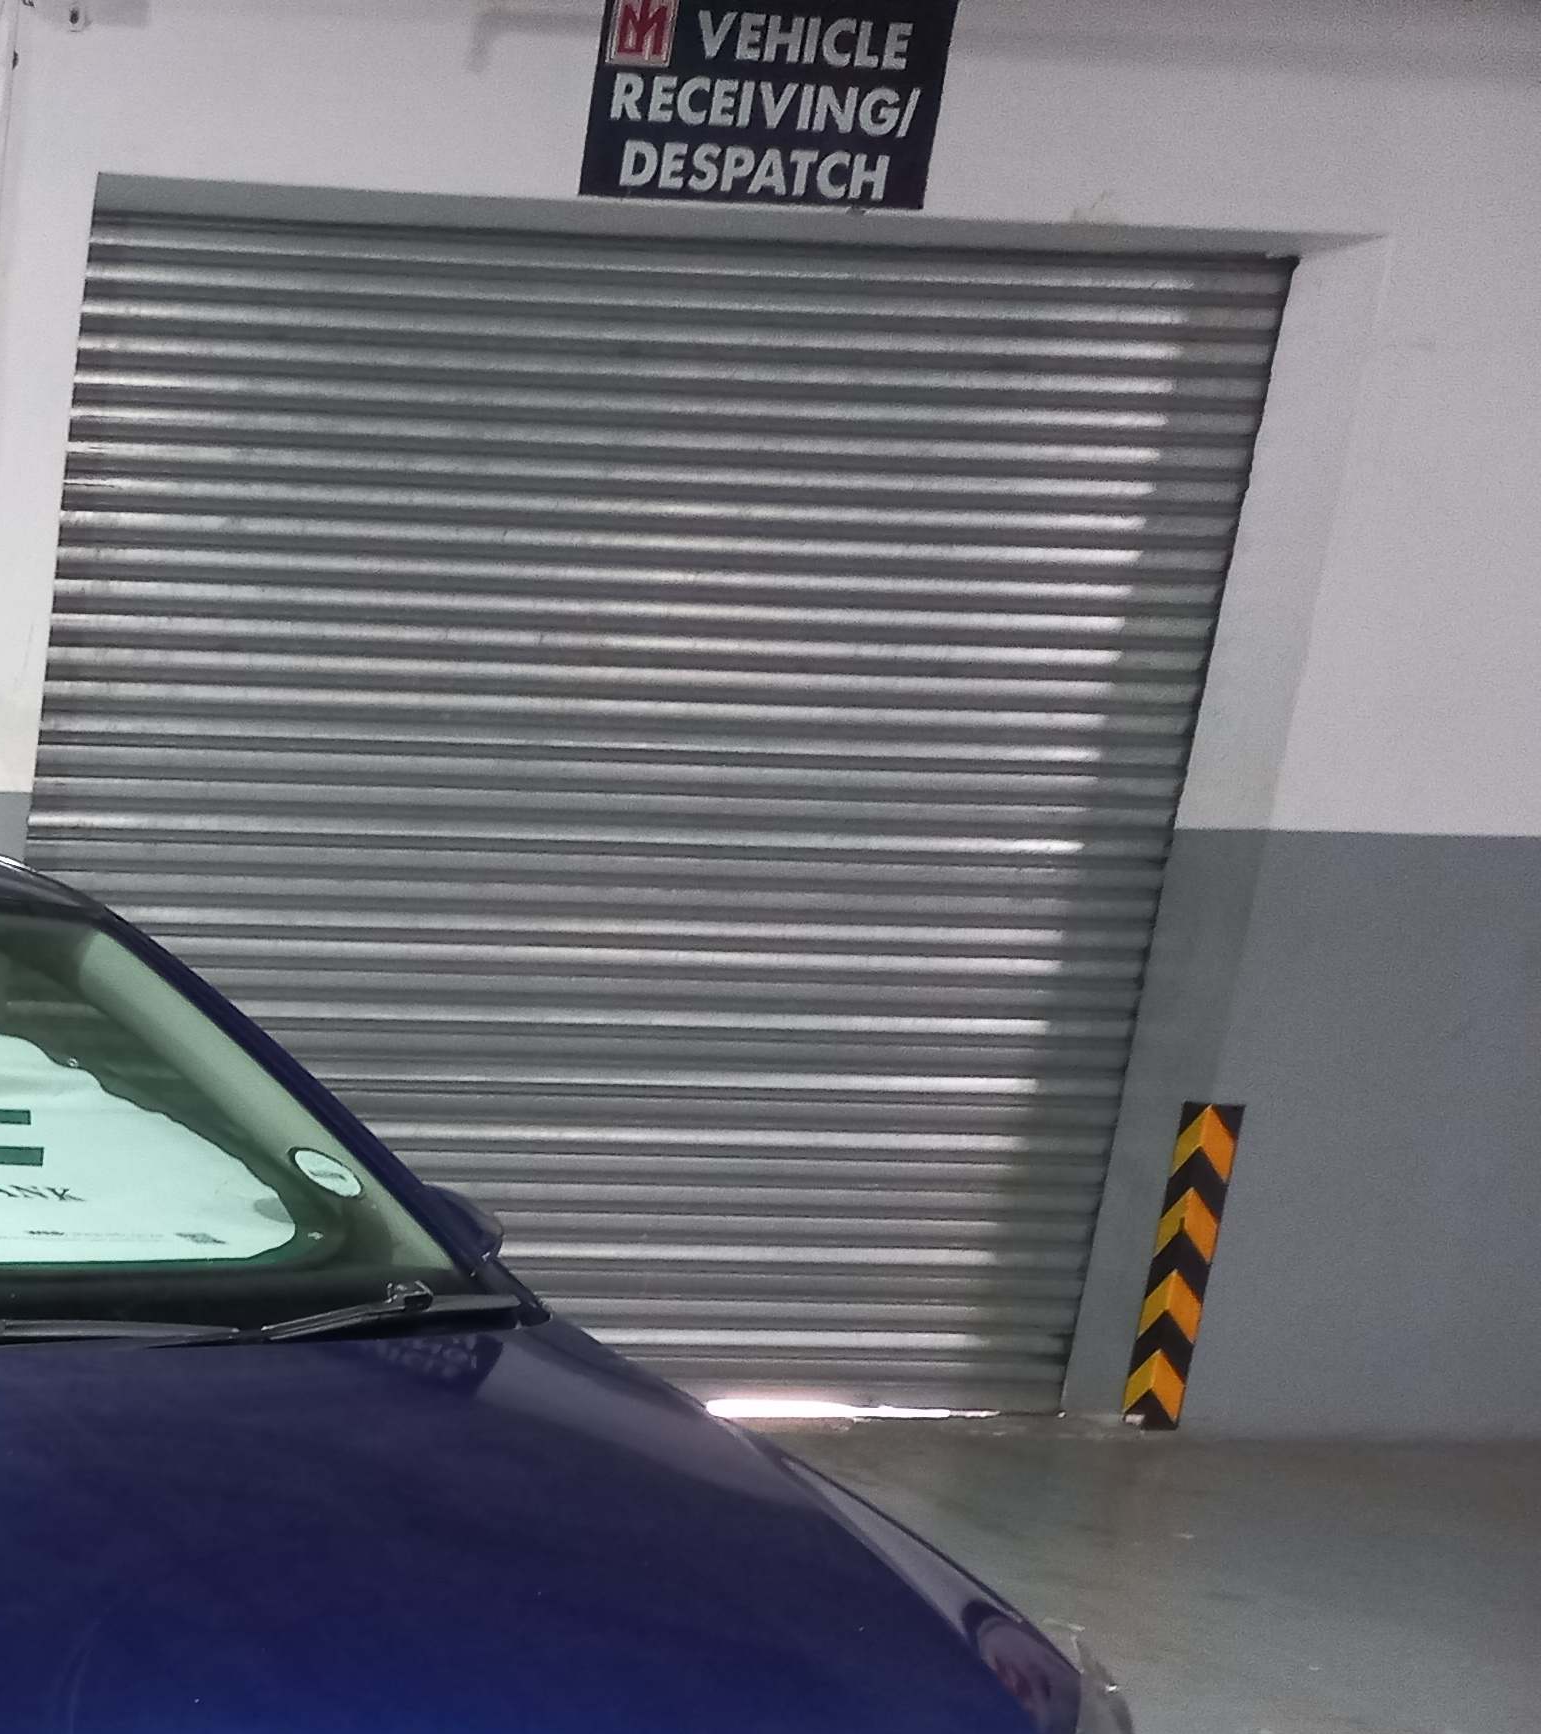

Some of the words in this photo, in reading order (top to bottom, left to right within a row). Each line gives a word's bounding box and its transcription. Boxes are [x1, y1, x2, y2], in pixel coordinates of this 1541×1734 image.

[698, 9, 914, 71] VEHICLE
[610, 72, 922, 138] RECEIVING/
[619, 139, 891, 200] DESPATCH
